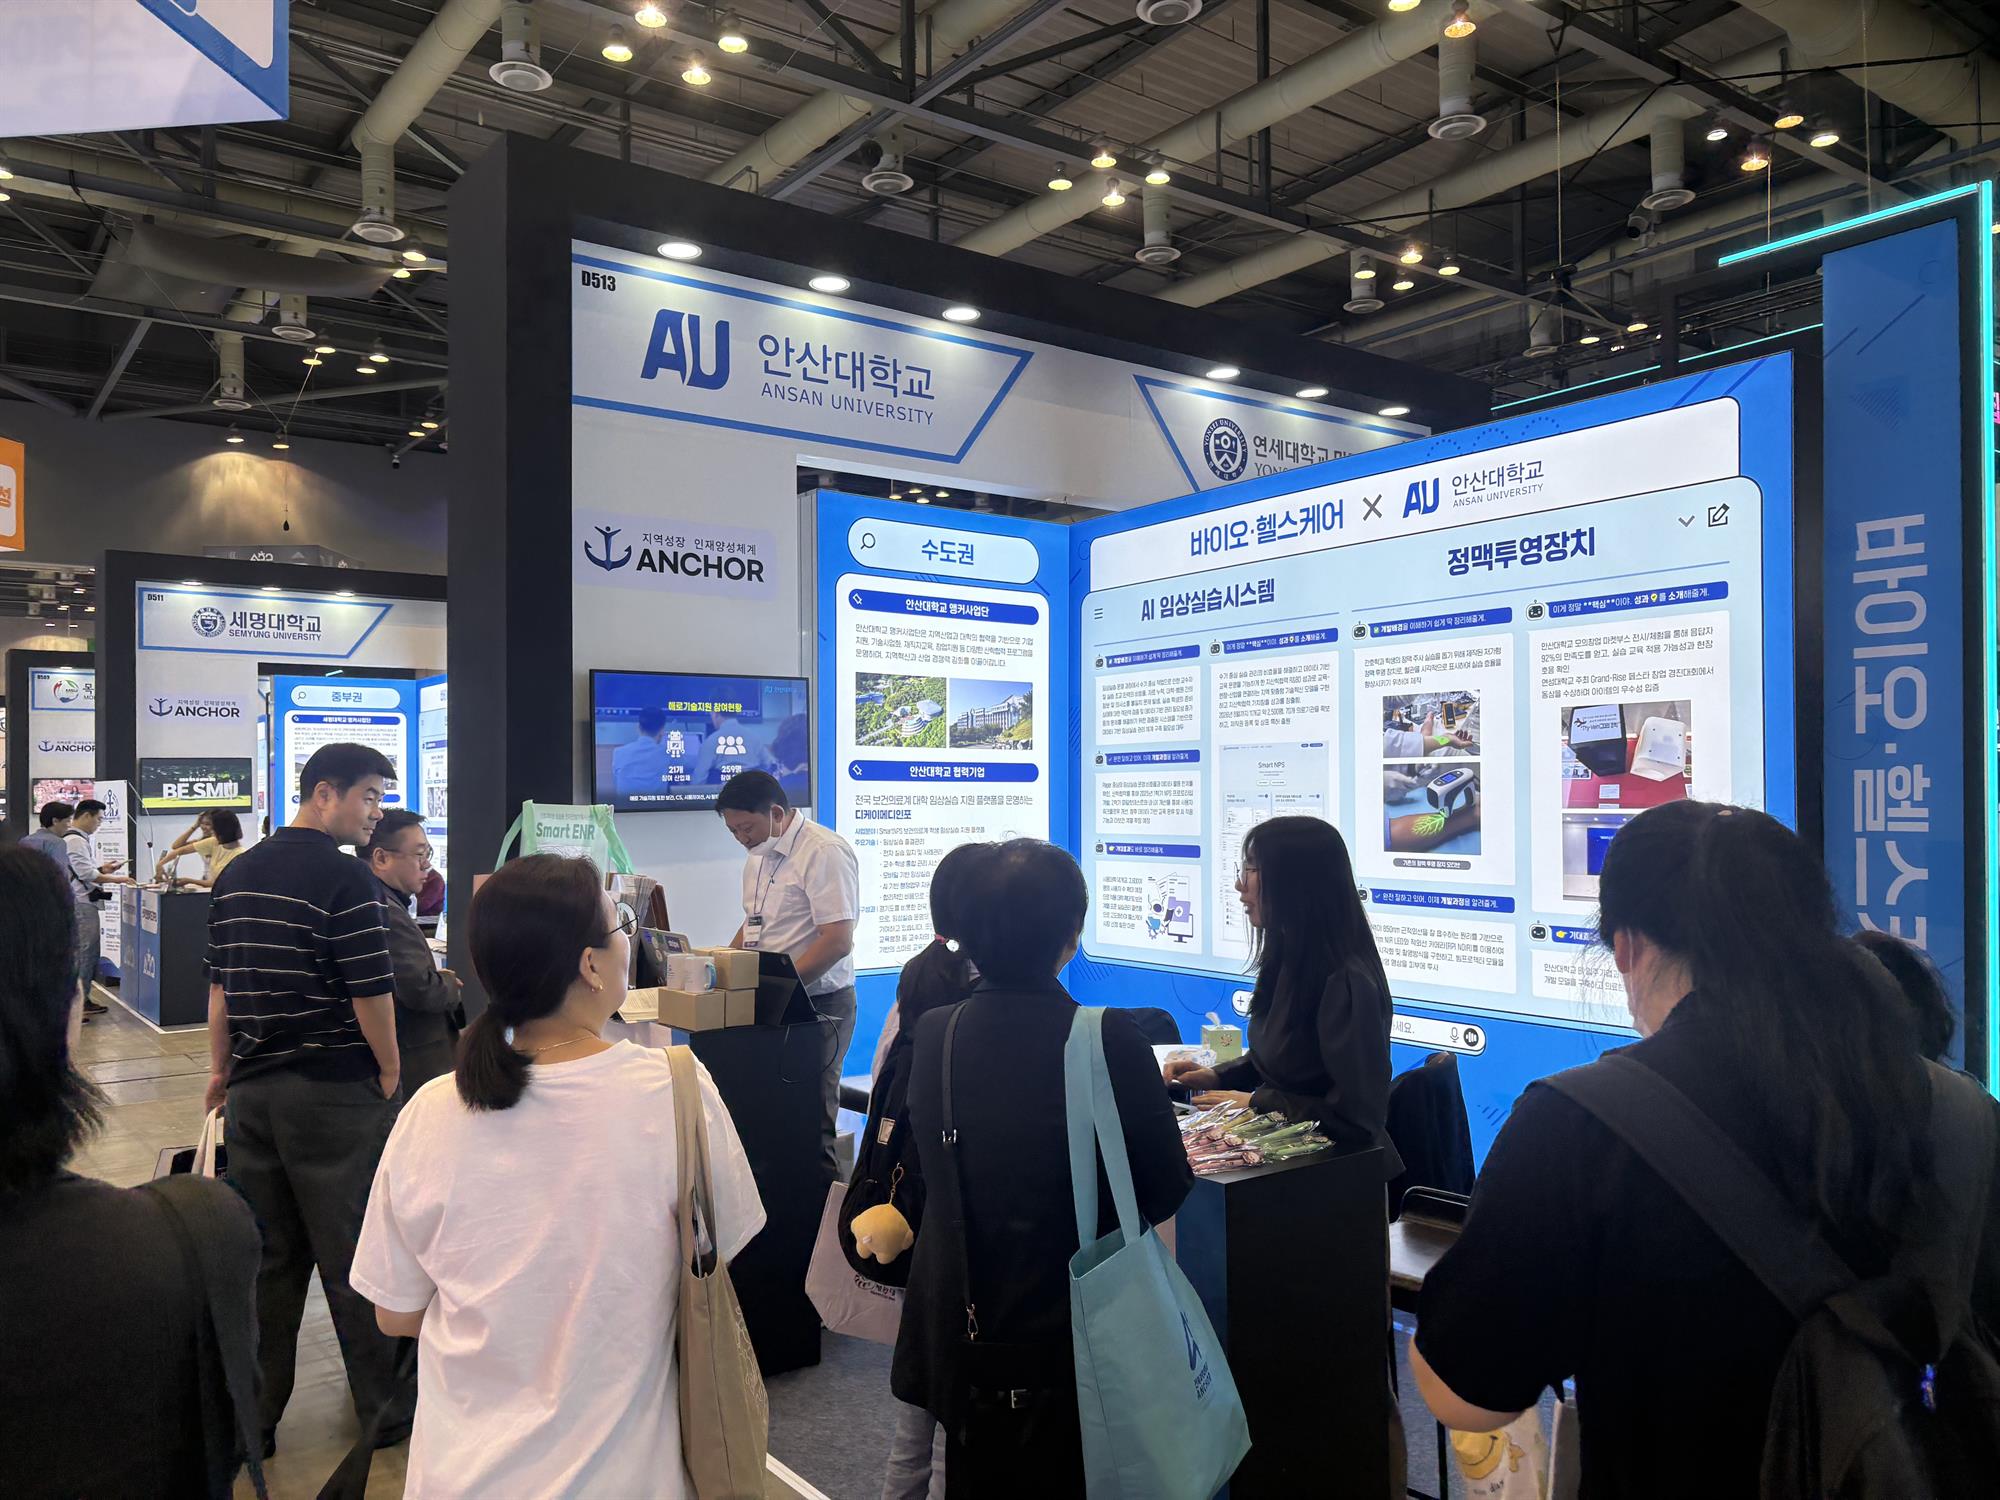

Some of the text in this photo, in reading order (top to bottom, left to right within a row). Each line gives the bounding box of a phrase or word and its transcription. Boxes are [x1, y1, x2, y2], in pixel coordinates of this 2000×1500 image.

[582, 270, 616, 291] D513
[640, 308, 730, 390] AU
[758, 334, 935, 400] 안산대학교
[761, 382, 935, 425] ANSAN UNIVERSITY
[1253, 435, 1329, 464] 연세대학교
[1452, 459, 1545, 497] 안산대학교
[1402, 477, 1440, 519] AU
[1452, 483, 1545, 508] ANSAN UNIVERSITY
[1190, 500, 1344, 557] 바이오·헬스케어
[642, 533, 757, 555] 지역성장 인재양성체계
[921, 539, 975, 566] 수도권
[1447, 526, 1596, 577] 정맥투영장치
[636, 548, 764, 583] ANCHOR
[905, 598, 989, 618] 안산대학교 앵커사업단
[1141, 578, 1276, 622] AI 임상실습시스템
[1552, 604, 1567, 614] 이게
[1634, 594, 1649, 605] 성과
[229, 611, 322, 633] 세명대학교
[856, 624, 888, 635] 안산대학교
[228, 629, 322, 641] SEMYUNG UNIVERSITY
[174, 706, 240, 718] ANCHOR
[910, 766, 985, 778] 안산대학교 협력기업
[162, 782, 239, 800] BE SMU
[855, 795, 872, 806] 전국
[912, 794, 928, 806] 대학
[960, 794, 976, 806] 지원
[1005, 795, 1033, 806] 운영하는
[855, 809, 912, 820] 디케이메디인포
[536, 822, 596, 840] Smart ENR
